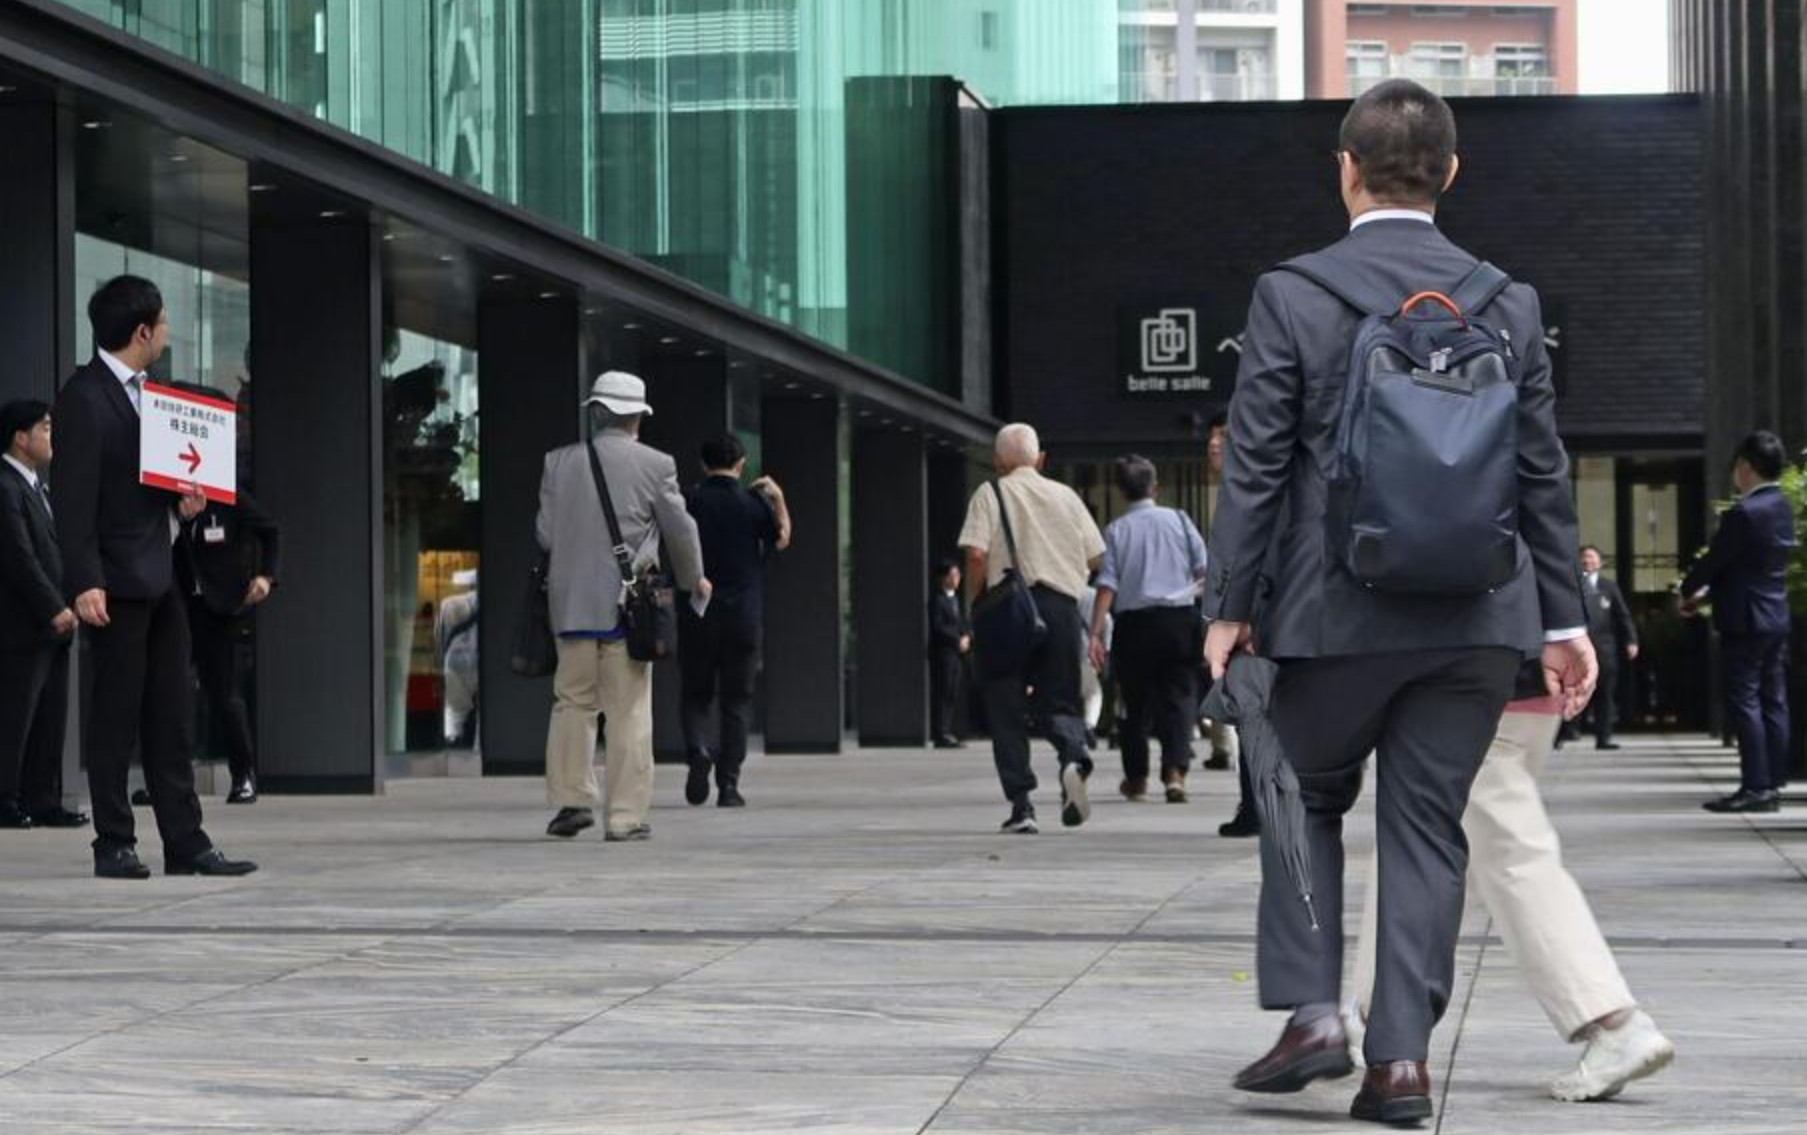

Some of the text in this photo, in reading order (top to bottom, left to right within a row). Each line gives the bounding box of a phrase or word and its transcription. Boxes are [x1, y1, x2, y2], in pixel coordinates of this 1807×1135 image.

[1127, 374, 1211, 391] belle salle
[169, 418, 209, 439] 株主総会
